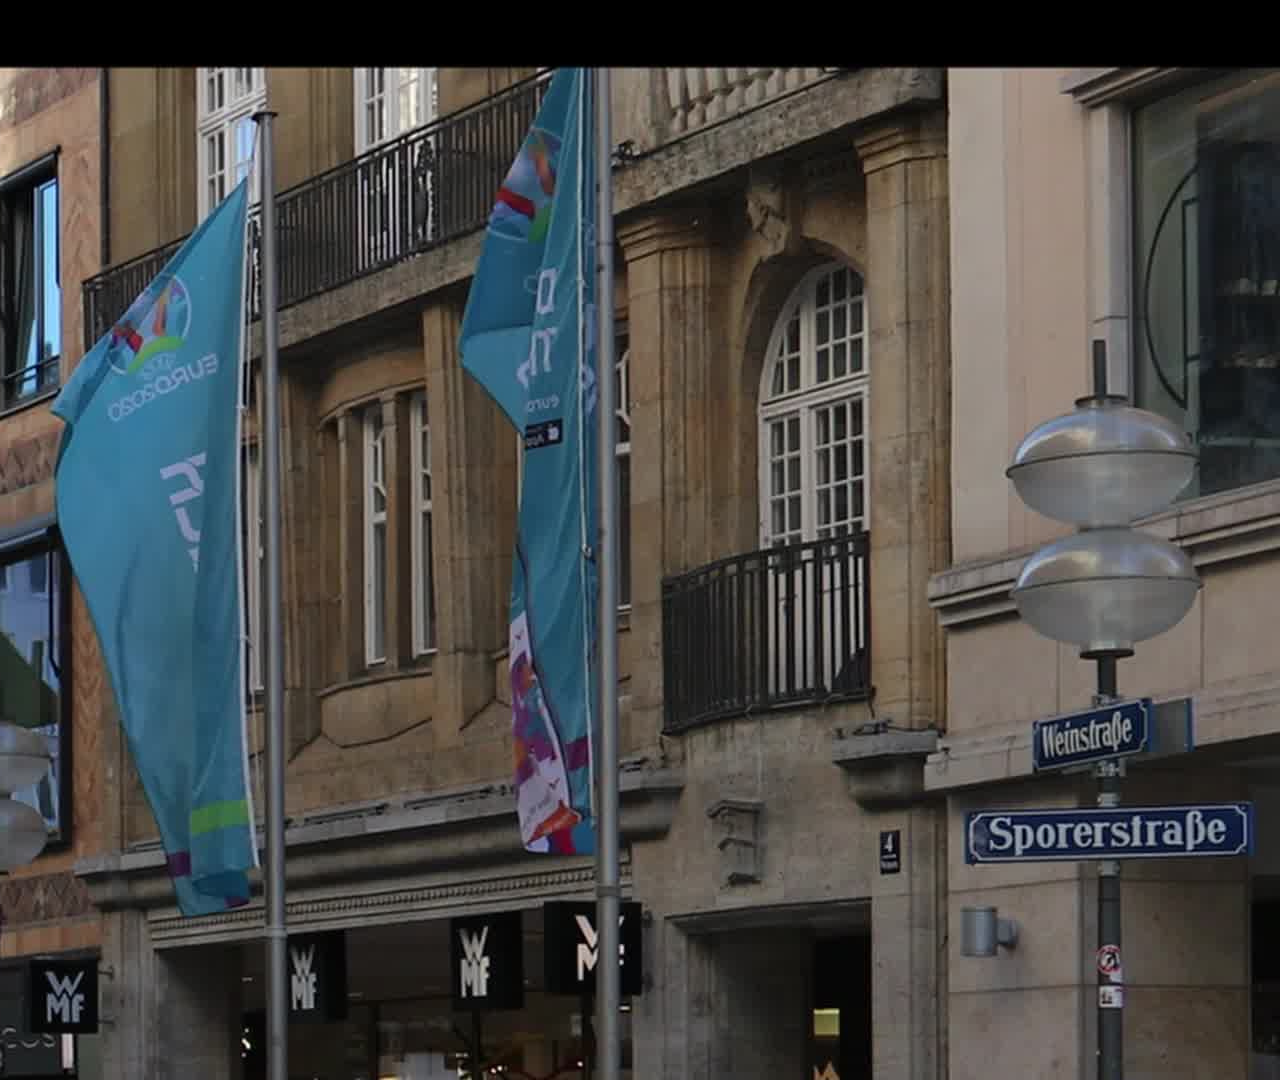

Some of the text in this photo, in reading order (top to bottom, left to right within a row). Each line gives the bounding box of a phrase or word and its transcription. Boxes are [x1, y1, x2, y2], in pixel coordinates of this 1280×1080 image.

[1041, 711, 1133, 759] Weinstraße
[883, 832, 894, 853] 4
[988, 810, 1227, 856] Sporerstraße
[289, 943, 319, 1012] WMF
[458, 924, 491, 998] WMF
[45, 969, 86, 1024] WMF
